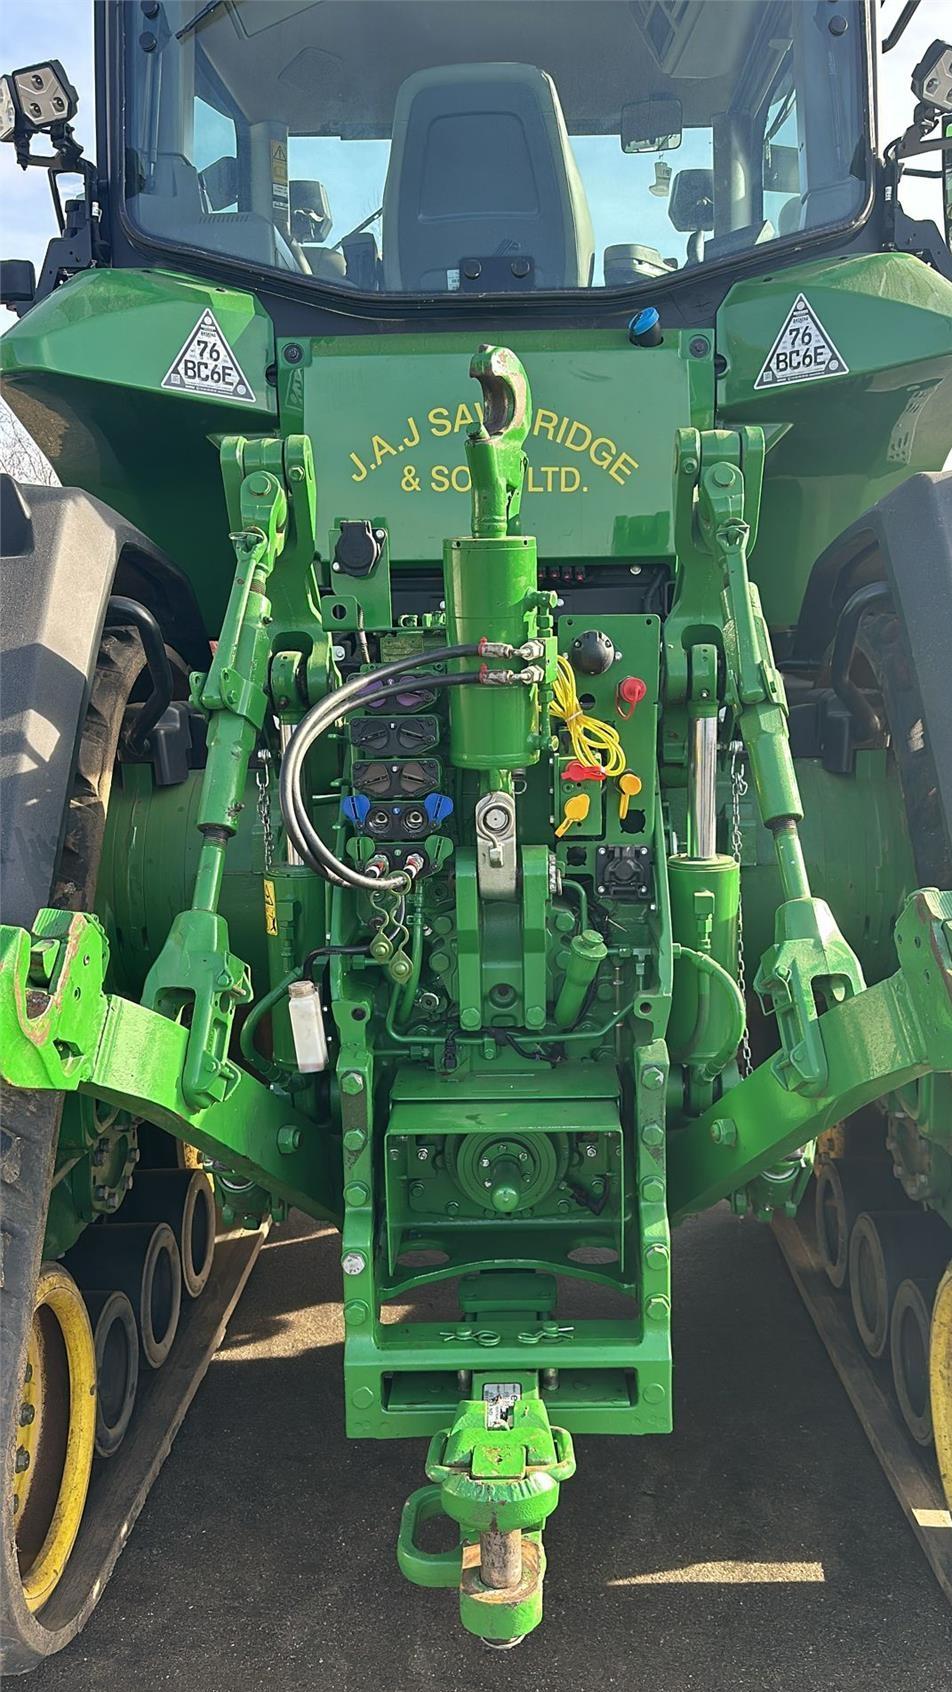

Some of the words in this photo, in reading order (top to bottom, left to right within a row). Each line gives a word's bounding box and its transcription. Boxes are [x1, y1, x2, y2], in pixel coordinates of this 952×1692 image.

[789, 326, 812, 347] 76
[197, 339, 220, 361] 76
[776, 345, 825, 372] BC6E
[184, 359, 234, 385] BC6E
[349, 417, 421, 483] J.A.J
[427, 402, 639, 486] SARIDGE
[400, 465, 422, 493] &
[527, 466, 588, 493] LTD.
